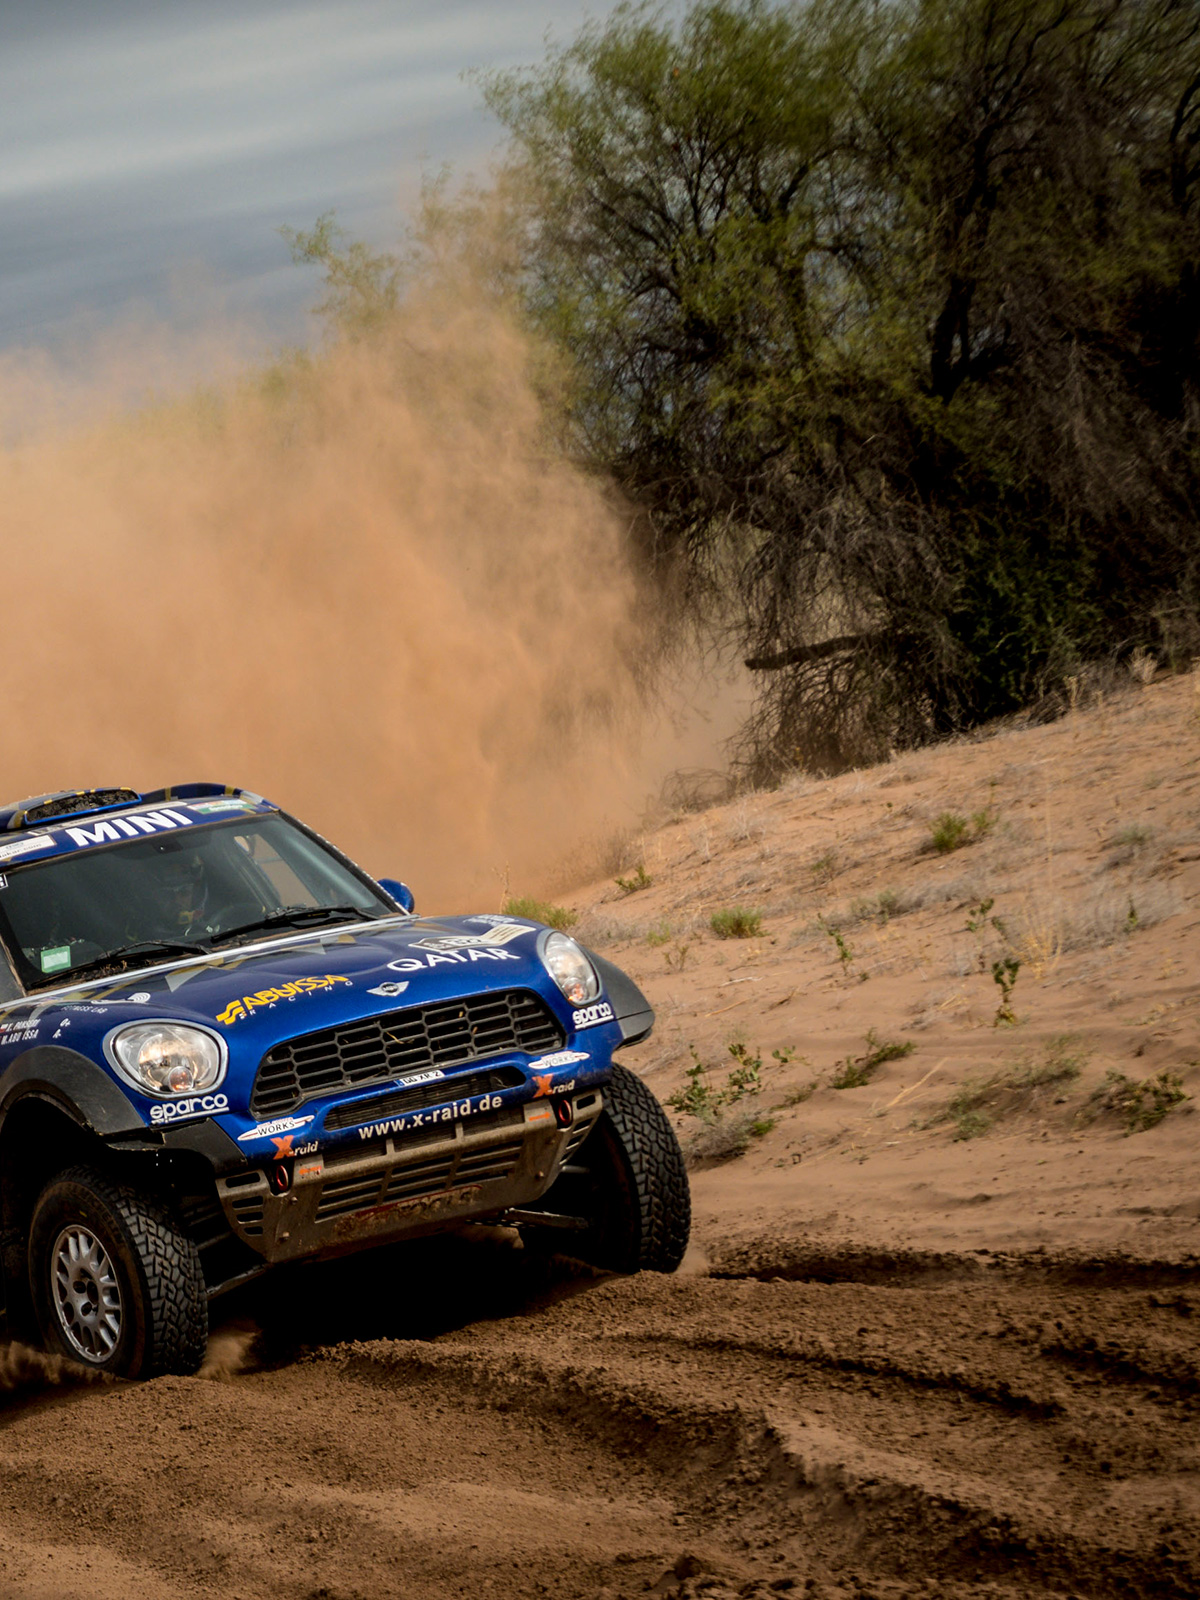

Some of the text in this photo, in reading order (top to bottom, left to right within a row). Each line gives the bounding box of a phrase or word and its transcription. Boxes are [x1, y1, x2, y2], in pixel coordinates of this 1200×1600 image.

[65, 808, 193, 847] MINI
[387, 948, 521, 972] QATAR
[572, 1002, 612, 1027] sparco
[542, 1053, 574, 1067] WORKS
[150, 1093, 229, 1122] sparco
[358, 1095, 503, 1140] www.x-raid.de
[258, 1121, 295, 1136] WORKS
